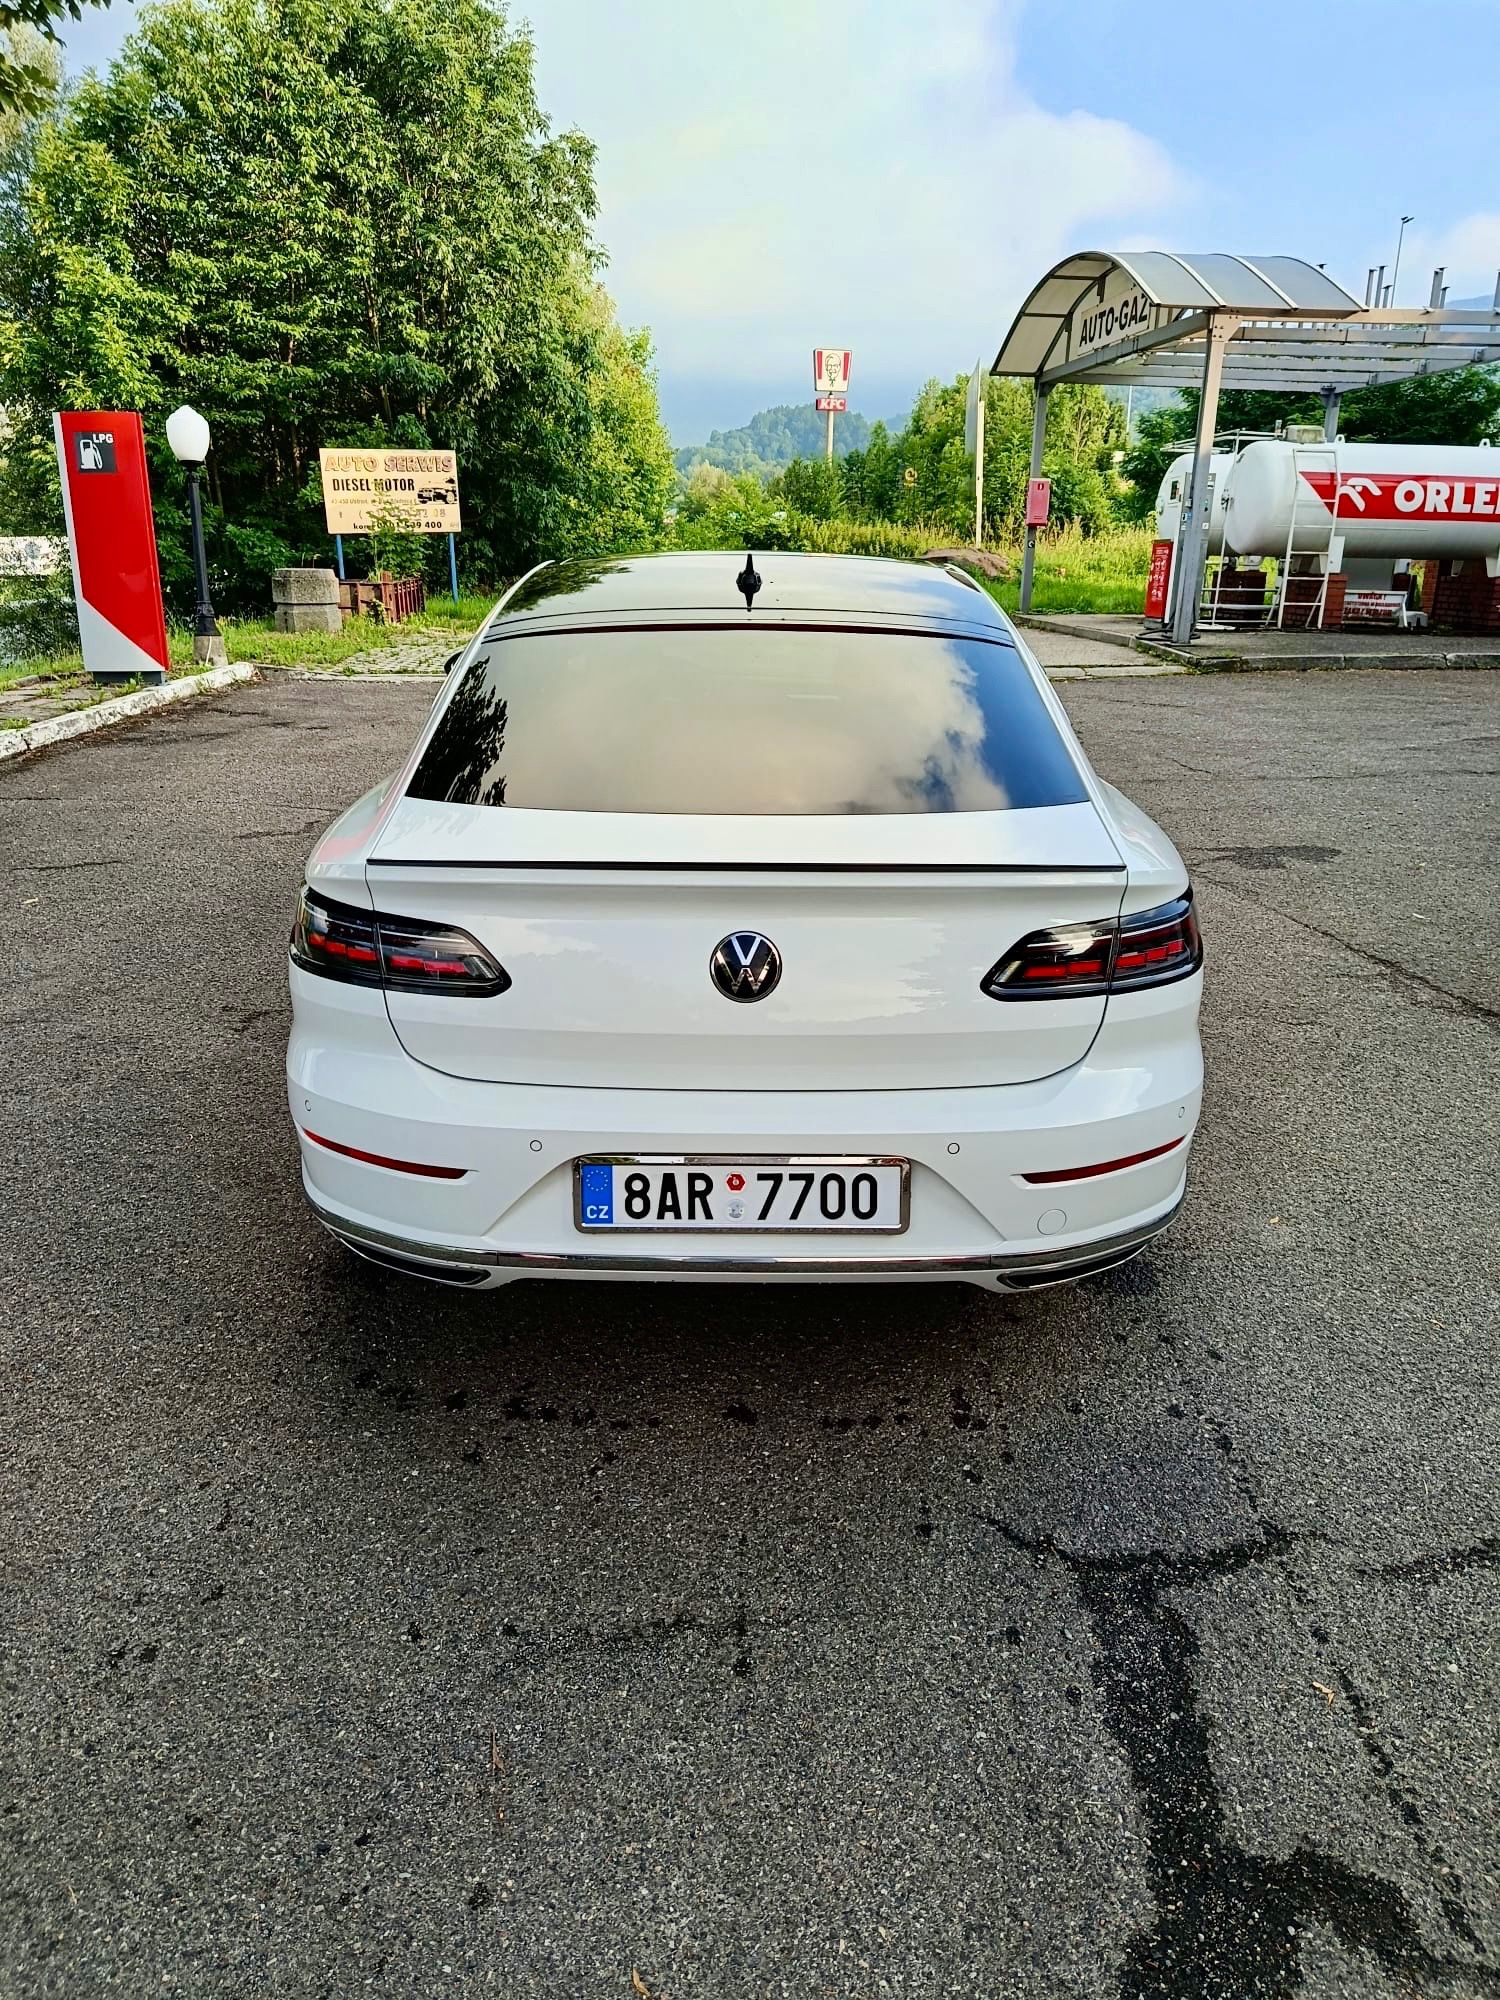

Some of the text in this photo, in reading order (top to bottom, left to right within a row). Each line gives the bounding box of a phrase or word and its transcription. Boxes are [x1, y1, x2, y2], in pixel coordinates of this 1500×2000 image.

[1079, 294, 1148, 347] AUTO-GAZ
[818, 399, 845, 409] KFC
[92, 433, 114, 443] LPG
[325, 456, 453, 472] AUTO SERWIS
[332, 478, 415, 491] DIESEL MOTOR
[1394, 479, 1500, 515] ORLE
[424, 521, 442, 529] 400
[624, 1172, 878, 1220] 8AR 7700
[586, 1205, 609, 1219] CZ
